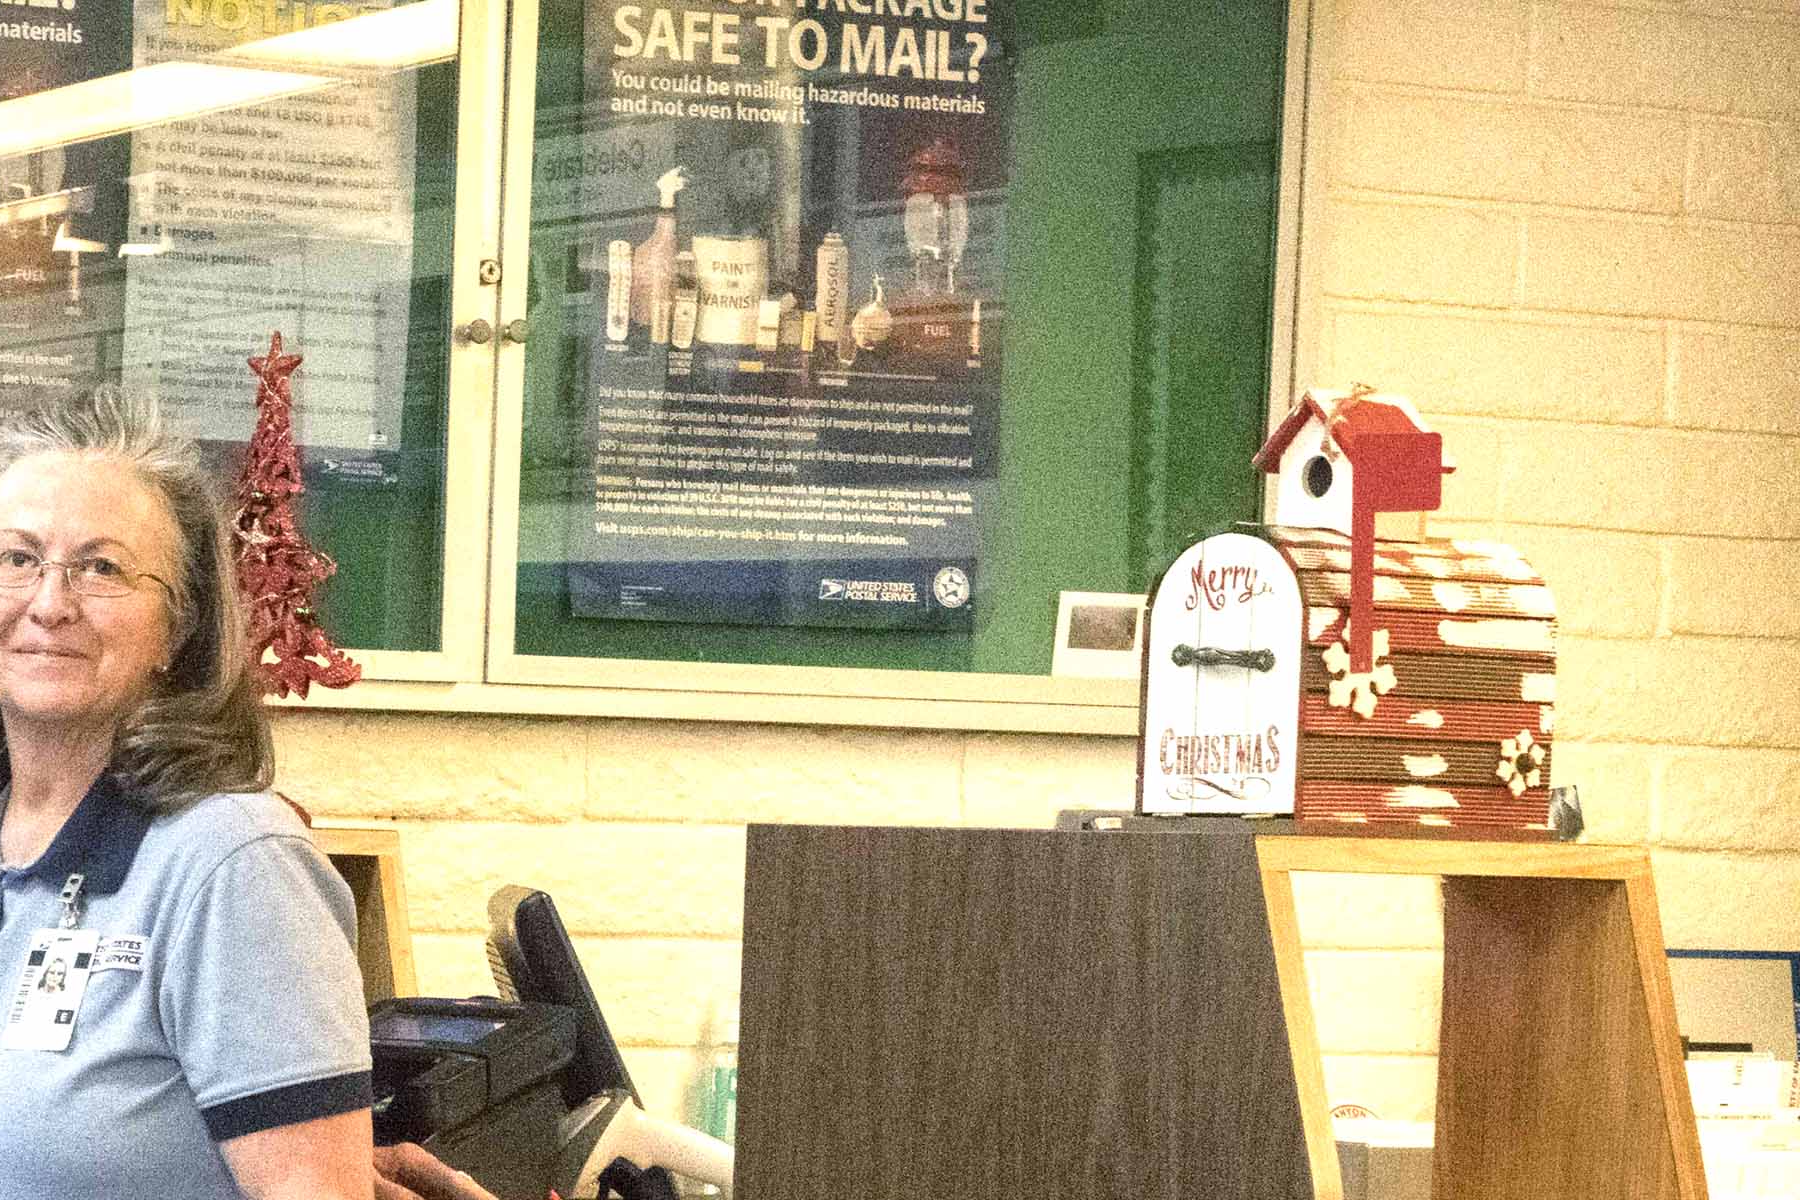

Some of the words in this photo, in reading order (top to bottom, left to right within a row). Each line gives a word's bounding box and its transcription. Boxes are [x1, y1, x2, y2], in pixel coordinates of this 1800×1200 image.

[614, 5, 741, 65] SAFE
[756, 17, 827, 71] TO
[841, 24, 988, 83] MAIL?
[612, 69, 645, 91] You
[650, 75, 701, 95] could
[706, 77, 730, 97] be
[735, 79, 805, 106] mailing
[808, 84, 899, 109] hazardous
[904, 94, 986, 116] materials
[611, 94, 647, 114] and
[653, 98, 685, 117] not
[689, 104, 731, 120] even
[737, 103, 792, 123] know
[792, 106, 811, 126] it.
[712, 260, 756, 277] PAINT
[924, 324, 951, 338] FUEL
[596, 521, 617, 534] Visit
[798, 529, 814, 542] for
[816, 533, 843, 543] more
[846, 531, 908, 546] information.
[844, 591, 879, 601] POSTAL
[880, 592, 918, 603] SERVICE
[847, 581, 882, 592] UNITED
[1185, 560, 1260, 611] Merry
[1160, 725, 1280, 776] CHRISTMAS
